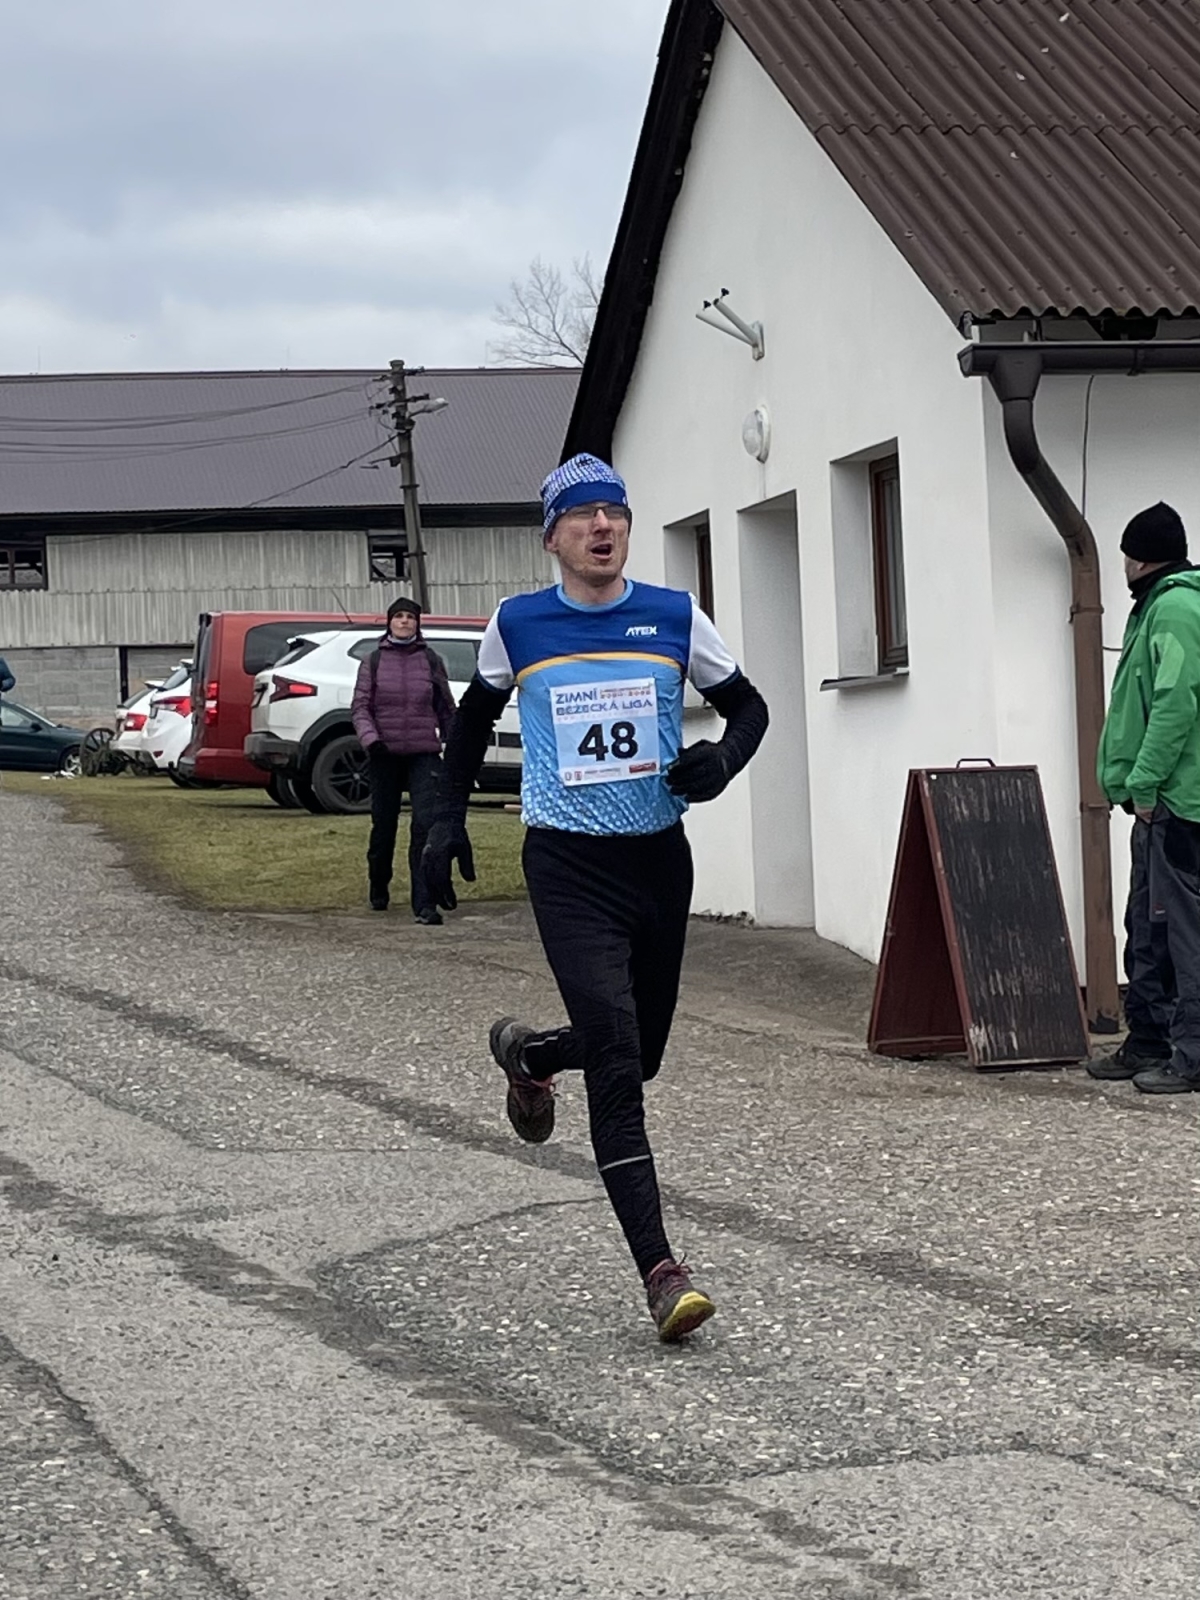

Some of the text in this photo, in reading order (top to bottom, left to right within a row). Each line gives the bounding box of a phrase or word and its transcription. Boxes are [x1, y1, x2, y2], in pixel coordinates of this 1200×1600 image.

[625, 625, 657, 637] ATEX
[555, 688, 598, 705] ZIMNÍ
[622, 699, 653, 710] LIGA
[577, 721, 638, 762] 48
